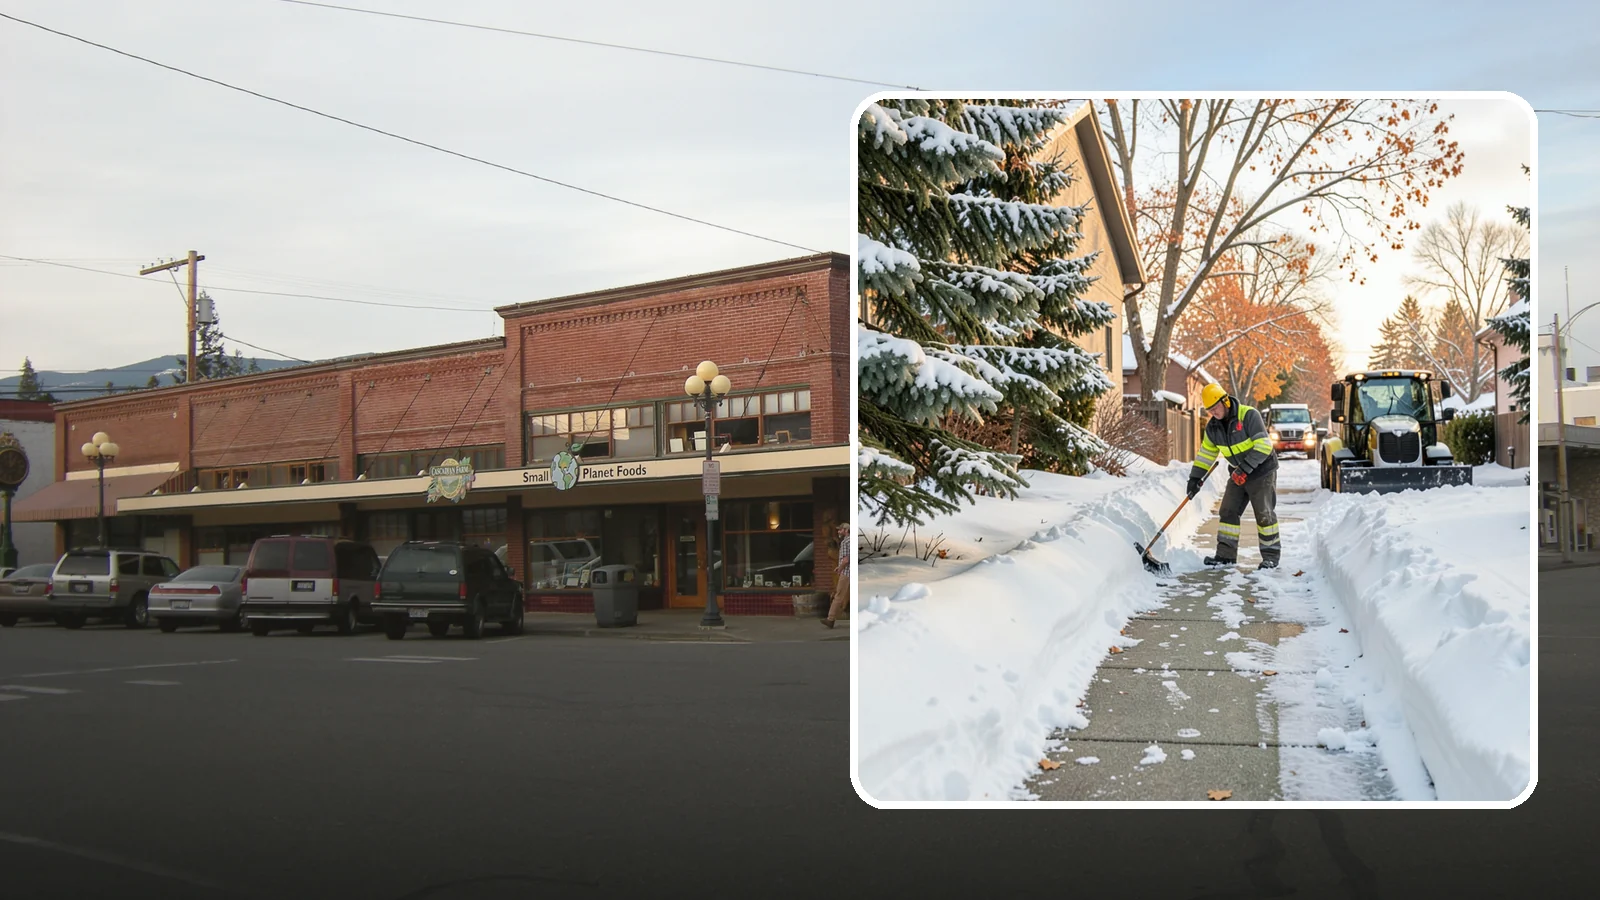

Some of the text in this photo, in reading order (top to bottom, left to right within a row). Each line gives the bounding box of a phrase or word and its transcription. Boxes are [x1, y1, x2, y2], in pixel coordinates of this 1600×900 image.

[523, 464, 647, 482] Small Planet Foods
